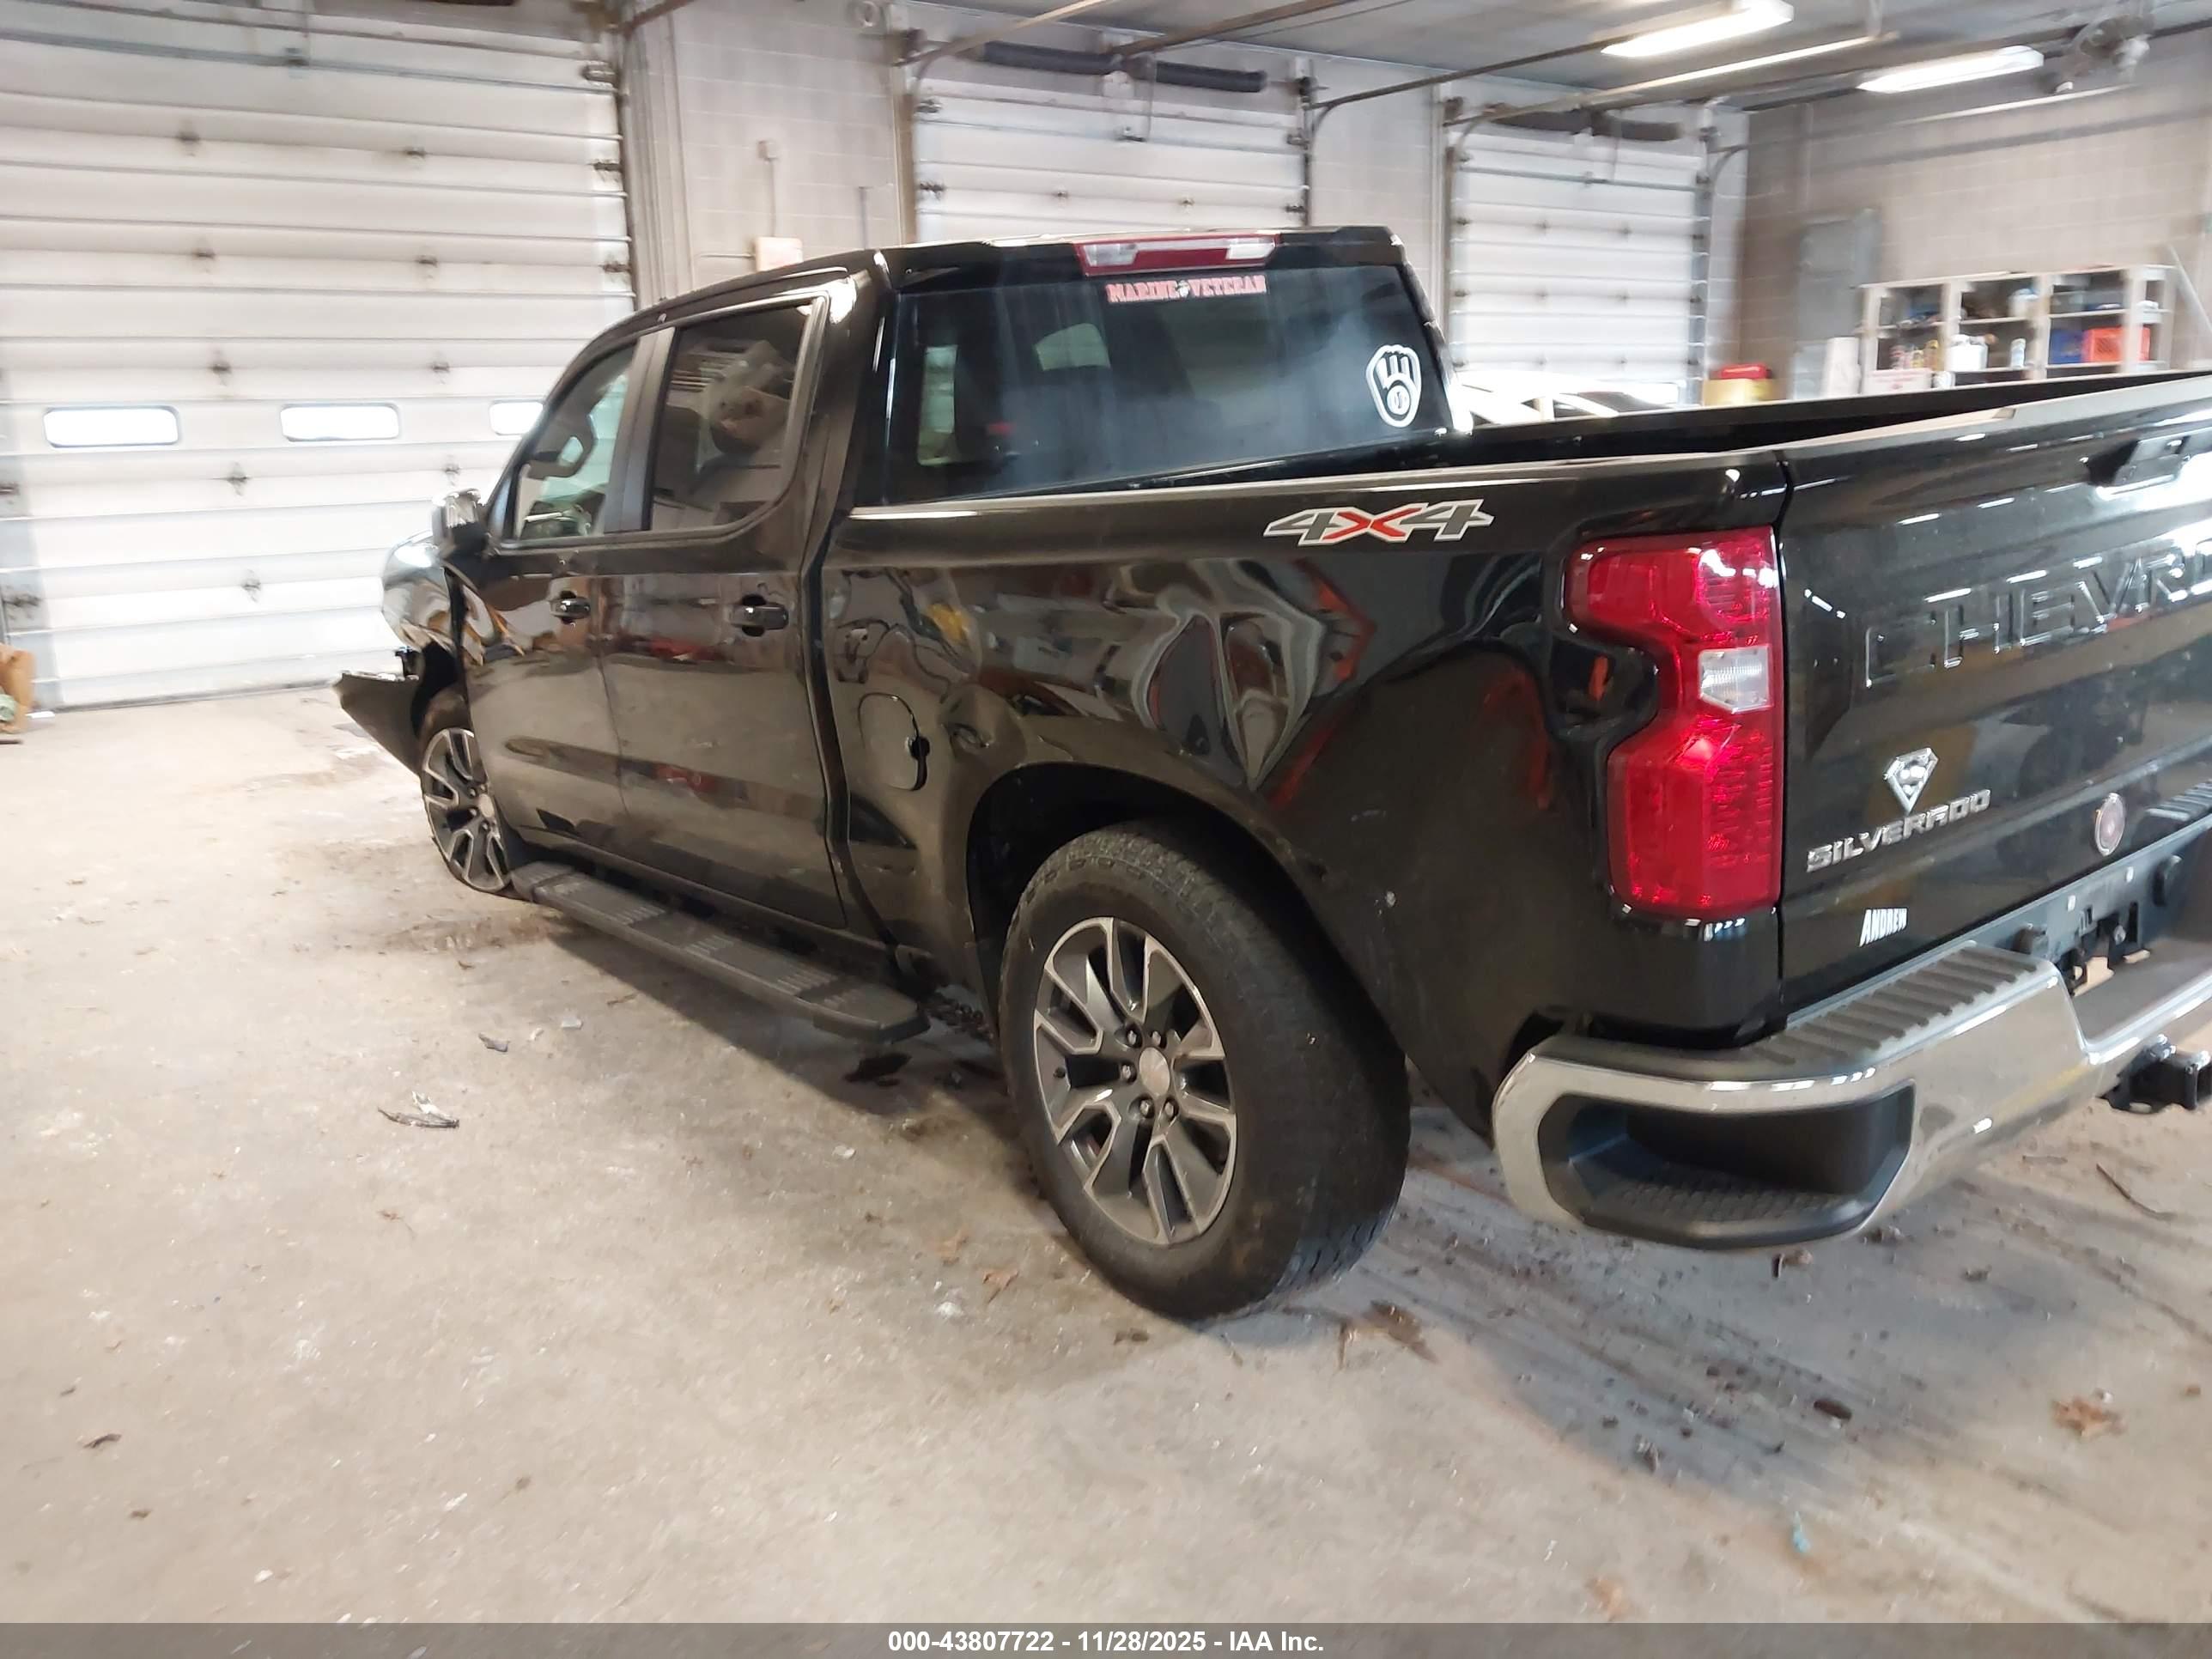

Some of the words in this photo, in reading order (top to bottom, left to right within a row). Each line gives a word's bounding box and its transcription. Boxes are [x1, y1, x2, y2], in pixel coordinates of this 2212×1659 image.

[1106, 281, 1180, 303] MARINE
[1188, 275, 1267, 297] VETERAN
[1865, 541, 2212, 690] CHEVR
[1807, 789, 1990, 873] SILVERADO
[1859, 908, 1908, 947] ANDREW
